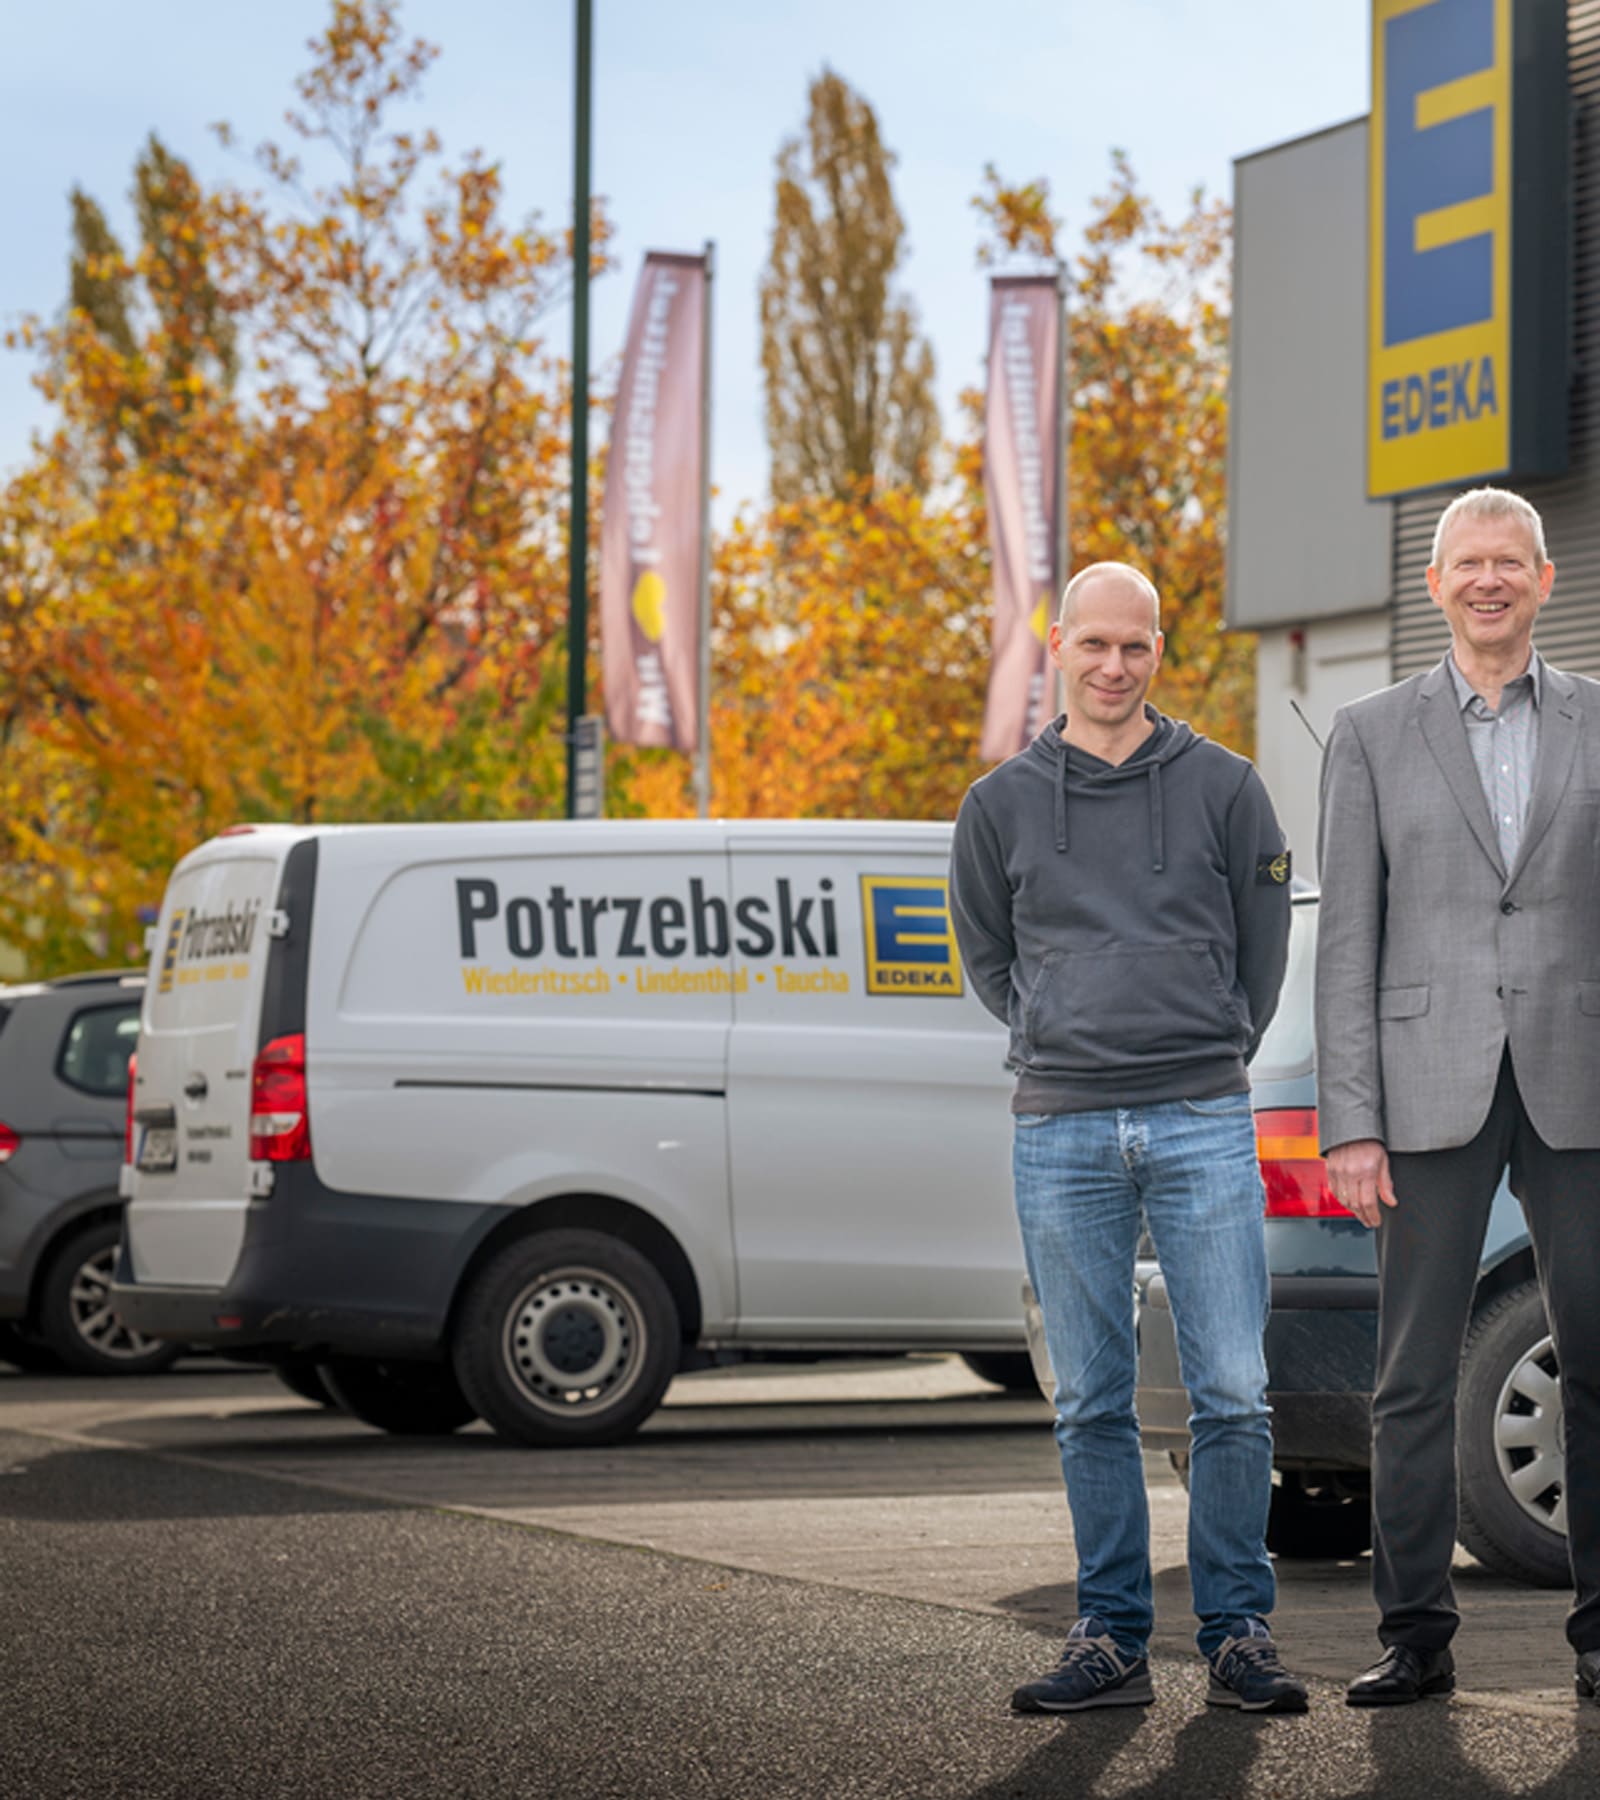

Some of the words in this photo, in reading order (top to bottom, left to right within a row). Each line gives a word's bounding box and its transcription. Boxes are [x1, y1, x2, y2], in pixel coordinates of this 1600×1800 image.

[1382, 355, 1498, 441] EDEKA
[455, 877, 839, 959] Potrzebski
[461, 966, 611, 994] Wiederitzsch
[636, 966, 749, 994] Lindenthal
[773, 965, 850, 993] Taucha
[876, 968, 955, 987] EDEKA
